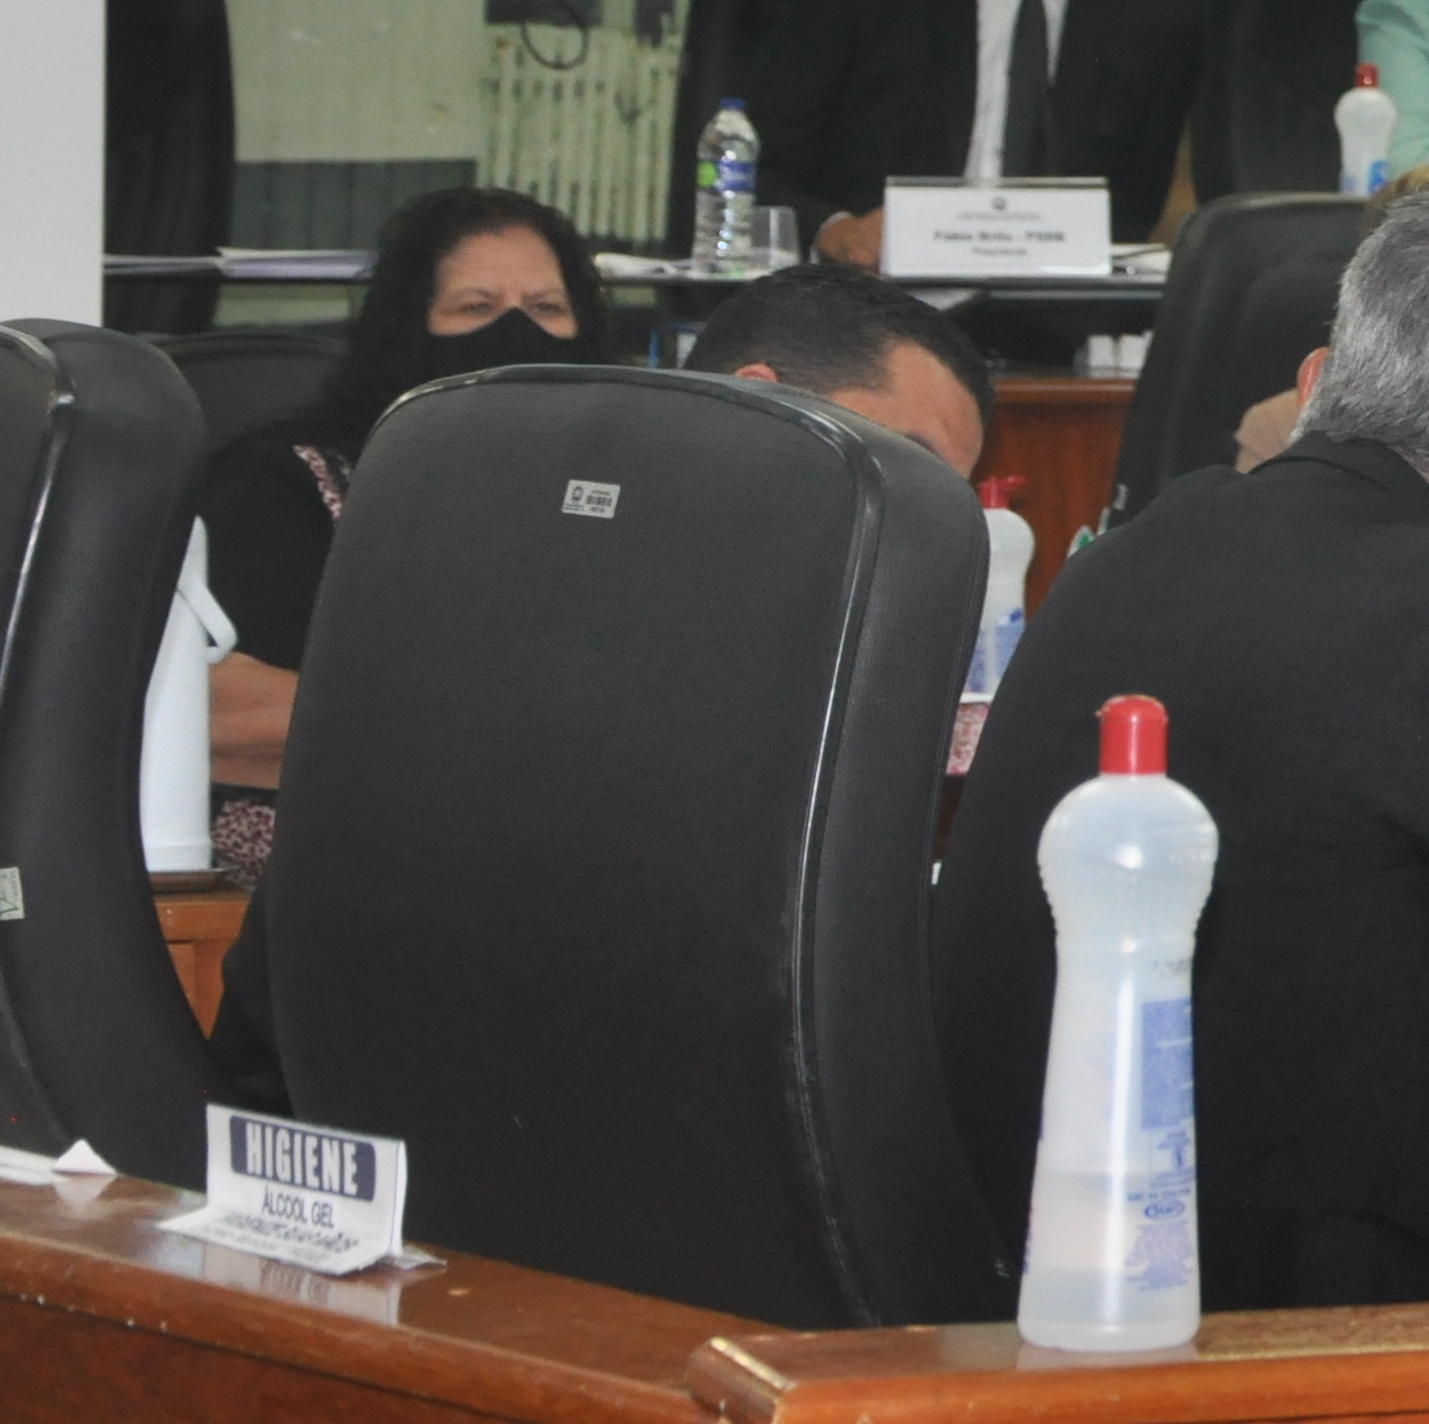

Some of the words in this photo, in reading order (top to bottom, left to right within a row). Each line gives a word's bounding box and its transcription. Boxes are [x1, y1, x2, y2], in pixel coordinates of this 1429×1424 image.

[245, 1121, 359, 1196] HIGIENE
[262, 1185, 308, 1223] ÁLCOOL
[311, 1201, 335, 1227] GEL
